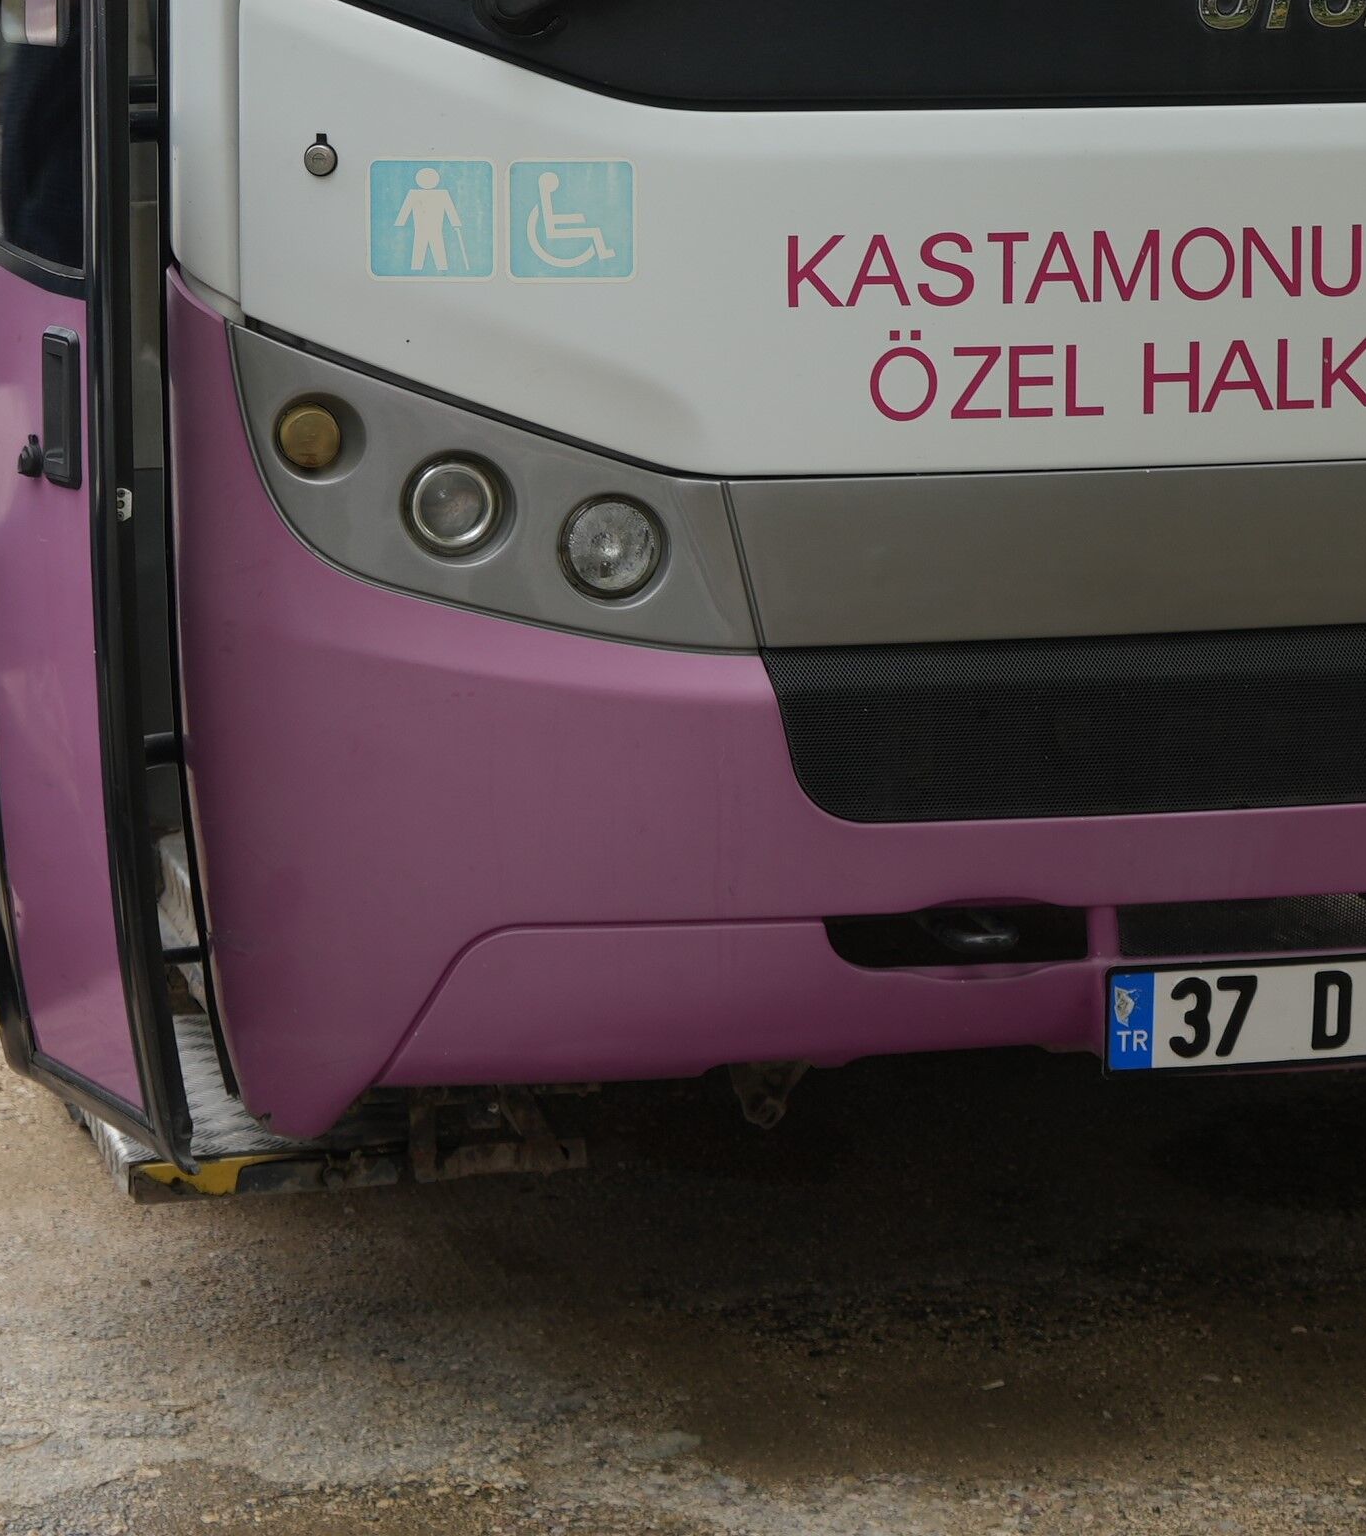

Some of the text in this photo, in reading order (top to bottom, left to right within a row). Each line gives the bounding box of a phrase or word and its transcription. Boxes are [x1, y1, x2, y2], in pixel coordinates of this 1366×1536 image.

[787, 224, 1363, 308] KASTAMONU
[869, 329, 1105, 422] ÖZEL
[1116, 1030, 1148, 1054] TR
[1168, 974, 1258, 1059] 37
[1310, 970, 1353, 1051] D
